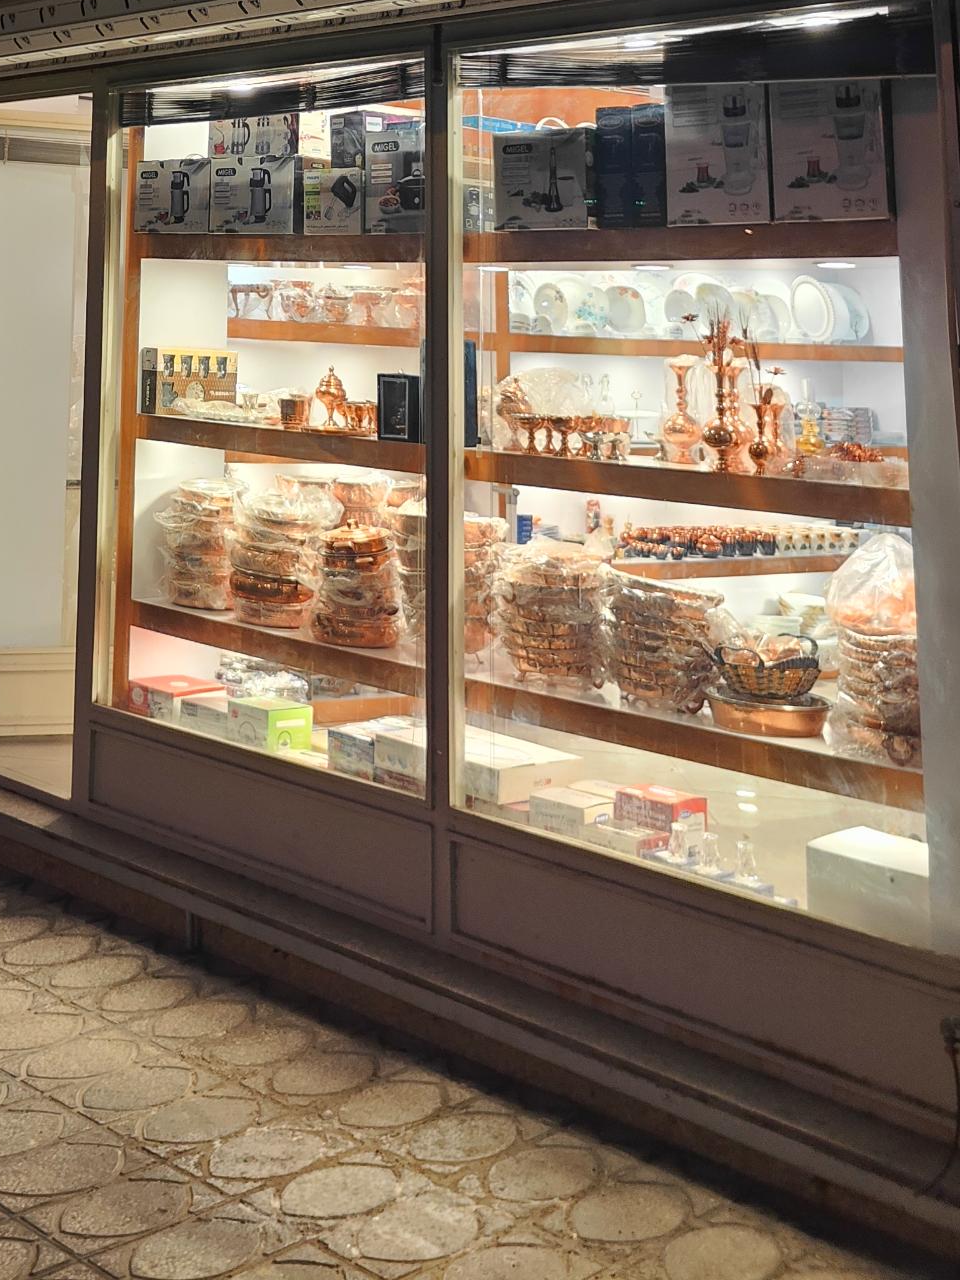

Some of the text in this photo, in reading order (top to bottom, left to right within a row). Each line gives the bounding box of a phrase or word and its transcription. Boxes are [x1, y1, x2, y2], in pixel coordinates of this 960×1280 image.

[373, 142, 397, 152] MIGEL
[505, 144, 529, 153] MIGEL
[141, 171, 158, 179] MIGEL
[216, 168, 236, 177] MIGEL
